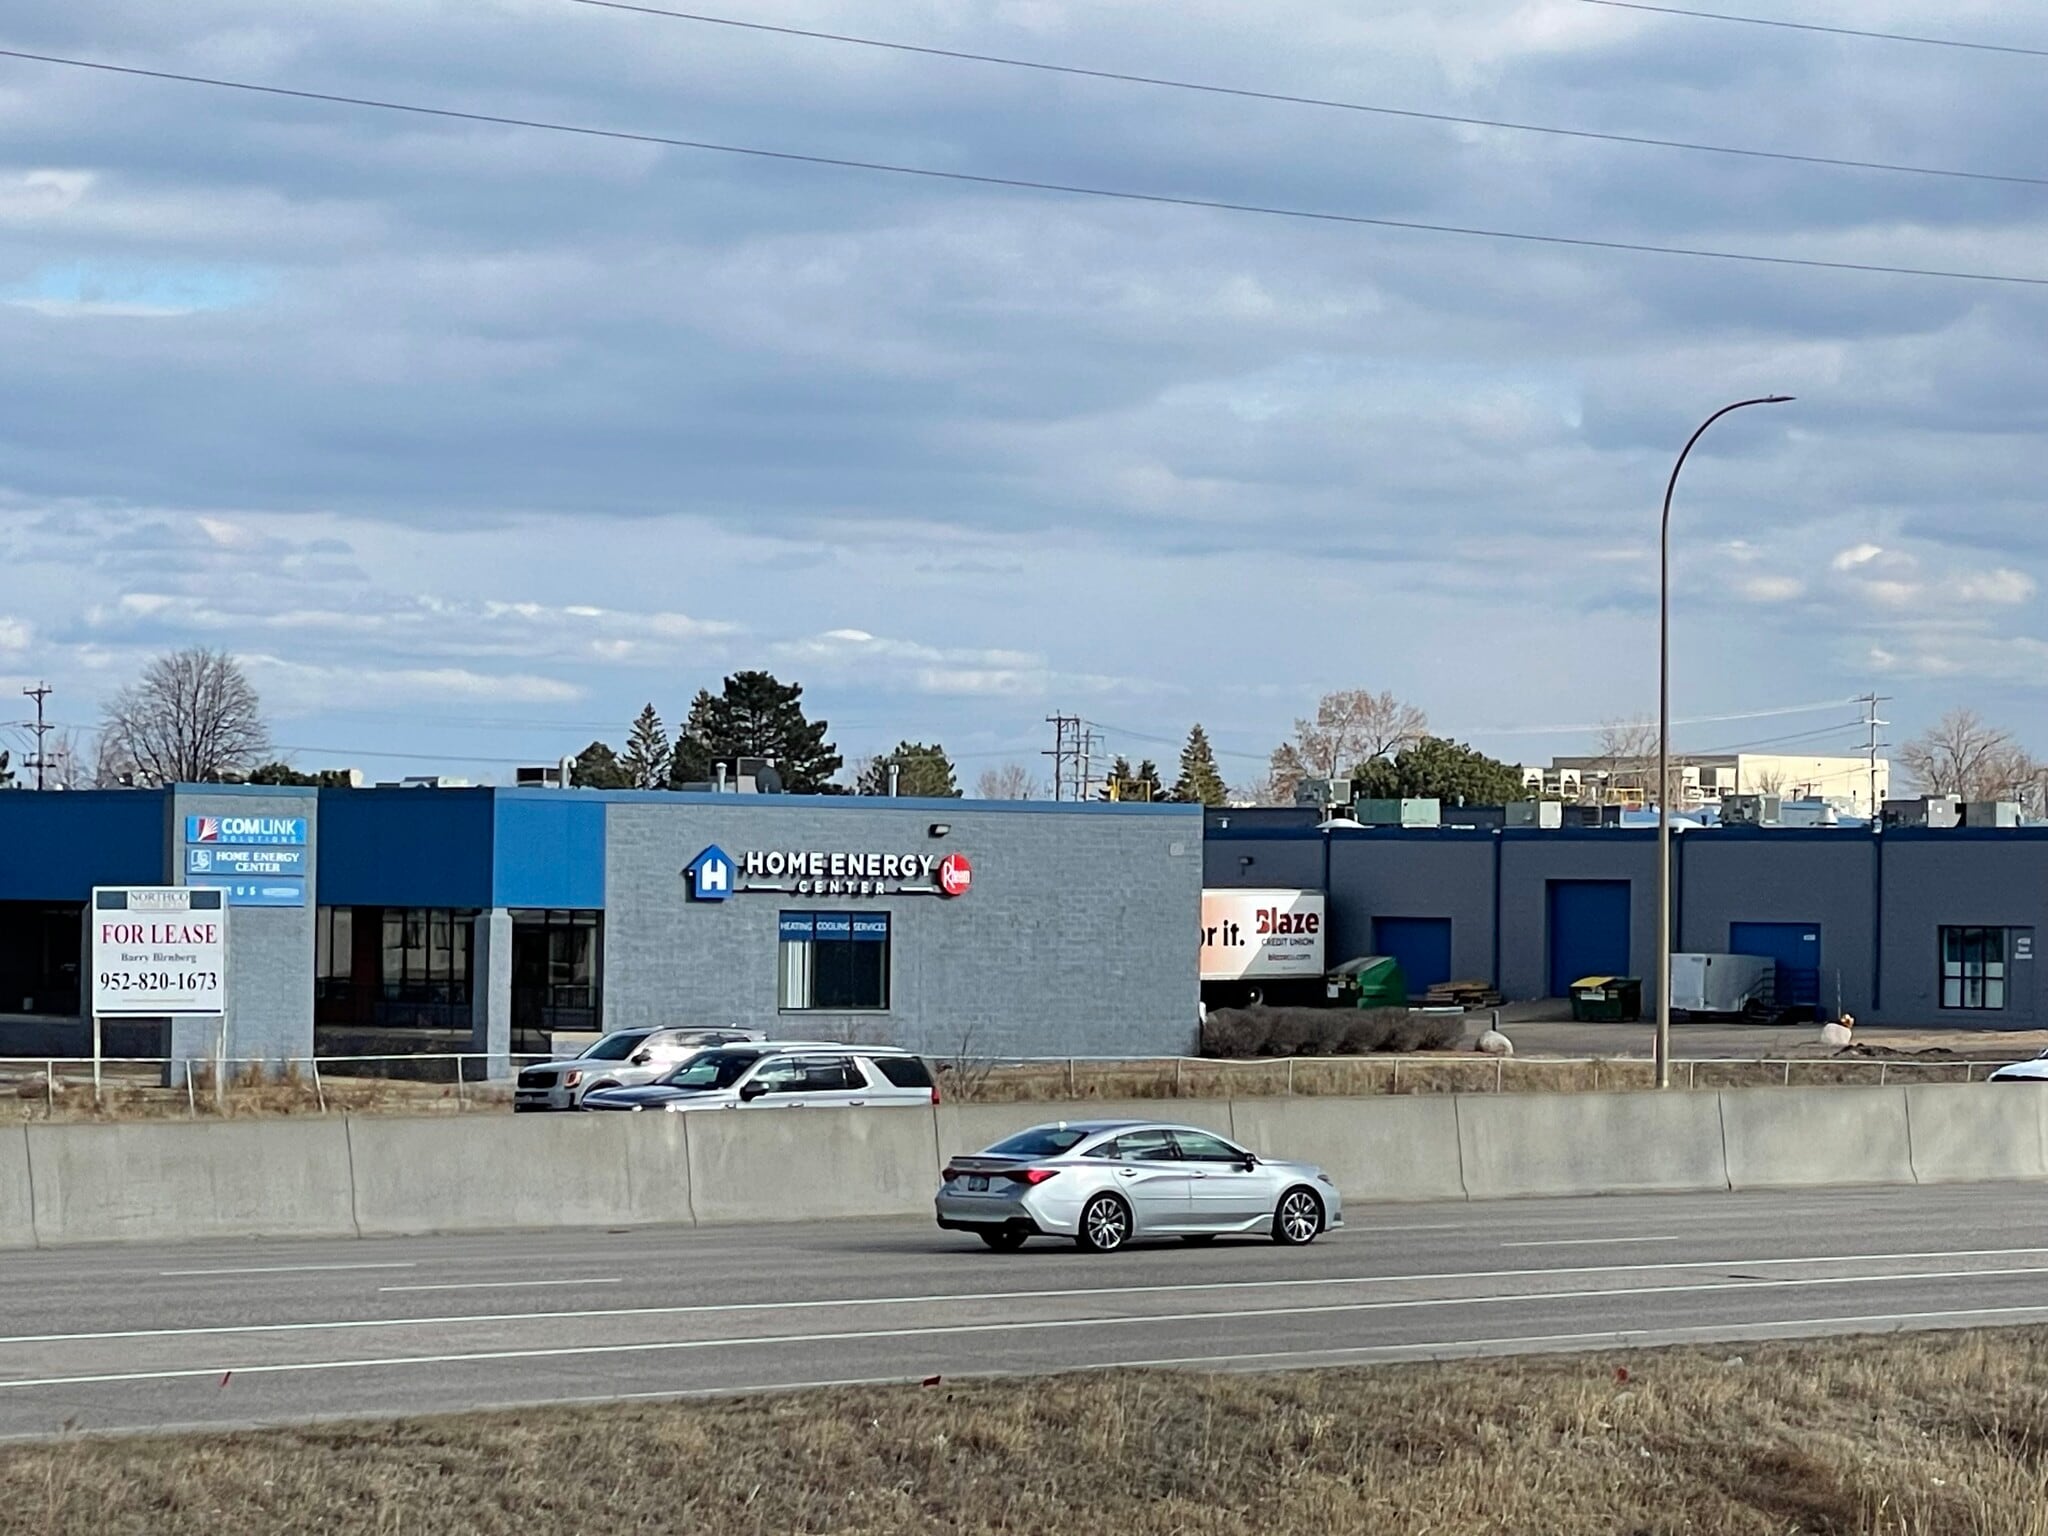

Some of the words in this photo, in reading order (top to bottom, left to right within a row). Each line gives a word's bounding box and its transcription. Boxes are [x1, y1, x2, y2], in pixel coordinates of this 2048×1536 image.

[221, 818, 297, 835] COMLINK
[216, 851, 250, 862] HOME
[253, 851, 300, 863] ENERGY
[745, 851, 825, 876] HOME
[831, 853, 935, 878] ENERGY
[235, 862, 281, 873] CENTER
[798, 880, 886, 895] CENTER
[130, 891, 189, 902] NORTHCO
[780, 921, 812, 931] HEATING
[816, 921, 851, 931] COOLING
[1256, 906, 1320, 935] Blaze
[101, 924, 145, 945] FOR
[151, 924, 218, 945] LEASE
[1223, 919, 1246, 947] it.
[1261, 937, 1289, 946] CREDIT
[1290, 937, 1315, 946] UNION
[121, 953, 149, 963] Barry
[100, 972, 218, 990] 952-820-1673
